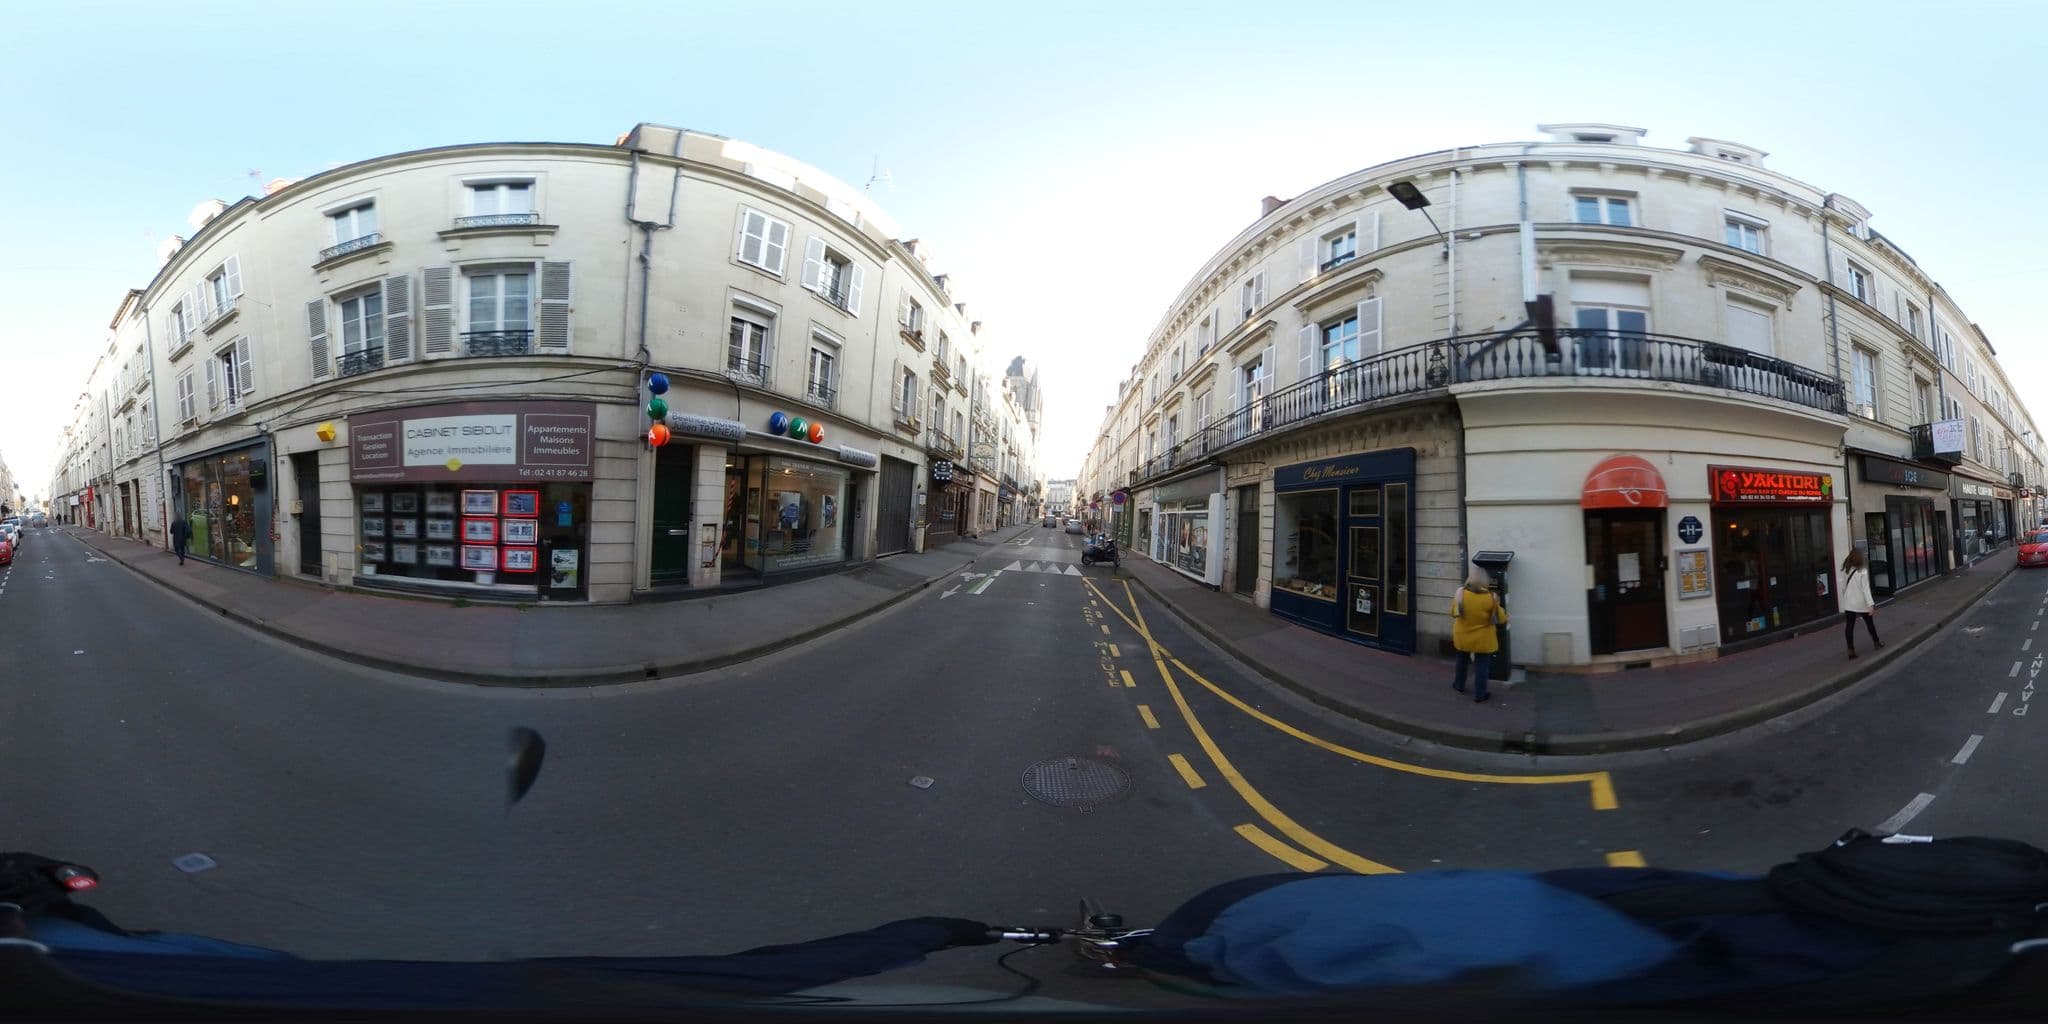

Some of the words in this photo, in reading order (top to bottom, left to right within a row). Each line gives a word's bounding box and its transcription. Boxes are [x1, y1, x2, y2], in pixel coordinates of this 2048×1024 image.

[407, 426, 458, 439] CABINET
[527, 425, 588, 434] Appartements
[699, 424, 742, 439] TRAINEAU
[540, 435, 575, 444] Maisons
[362, 443, 388, 451] Gestion
[407, 447, 445, 458] Agence
[533, 446, 581, 455] Immeubles
[361, 452, 389, 460] Location
[534, 469, 545, 477] 02
[546, 469, 555, 477] 41
[556, 469, 567, 477] 87
[1322, 464, 1360, 478] Monsieur
[1904, 469, 1918, 483] ICE
[1741, 472, 1819, 490] YAKITORI
[2012, 652, 2044, 716] PAYANT
